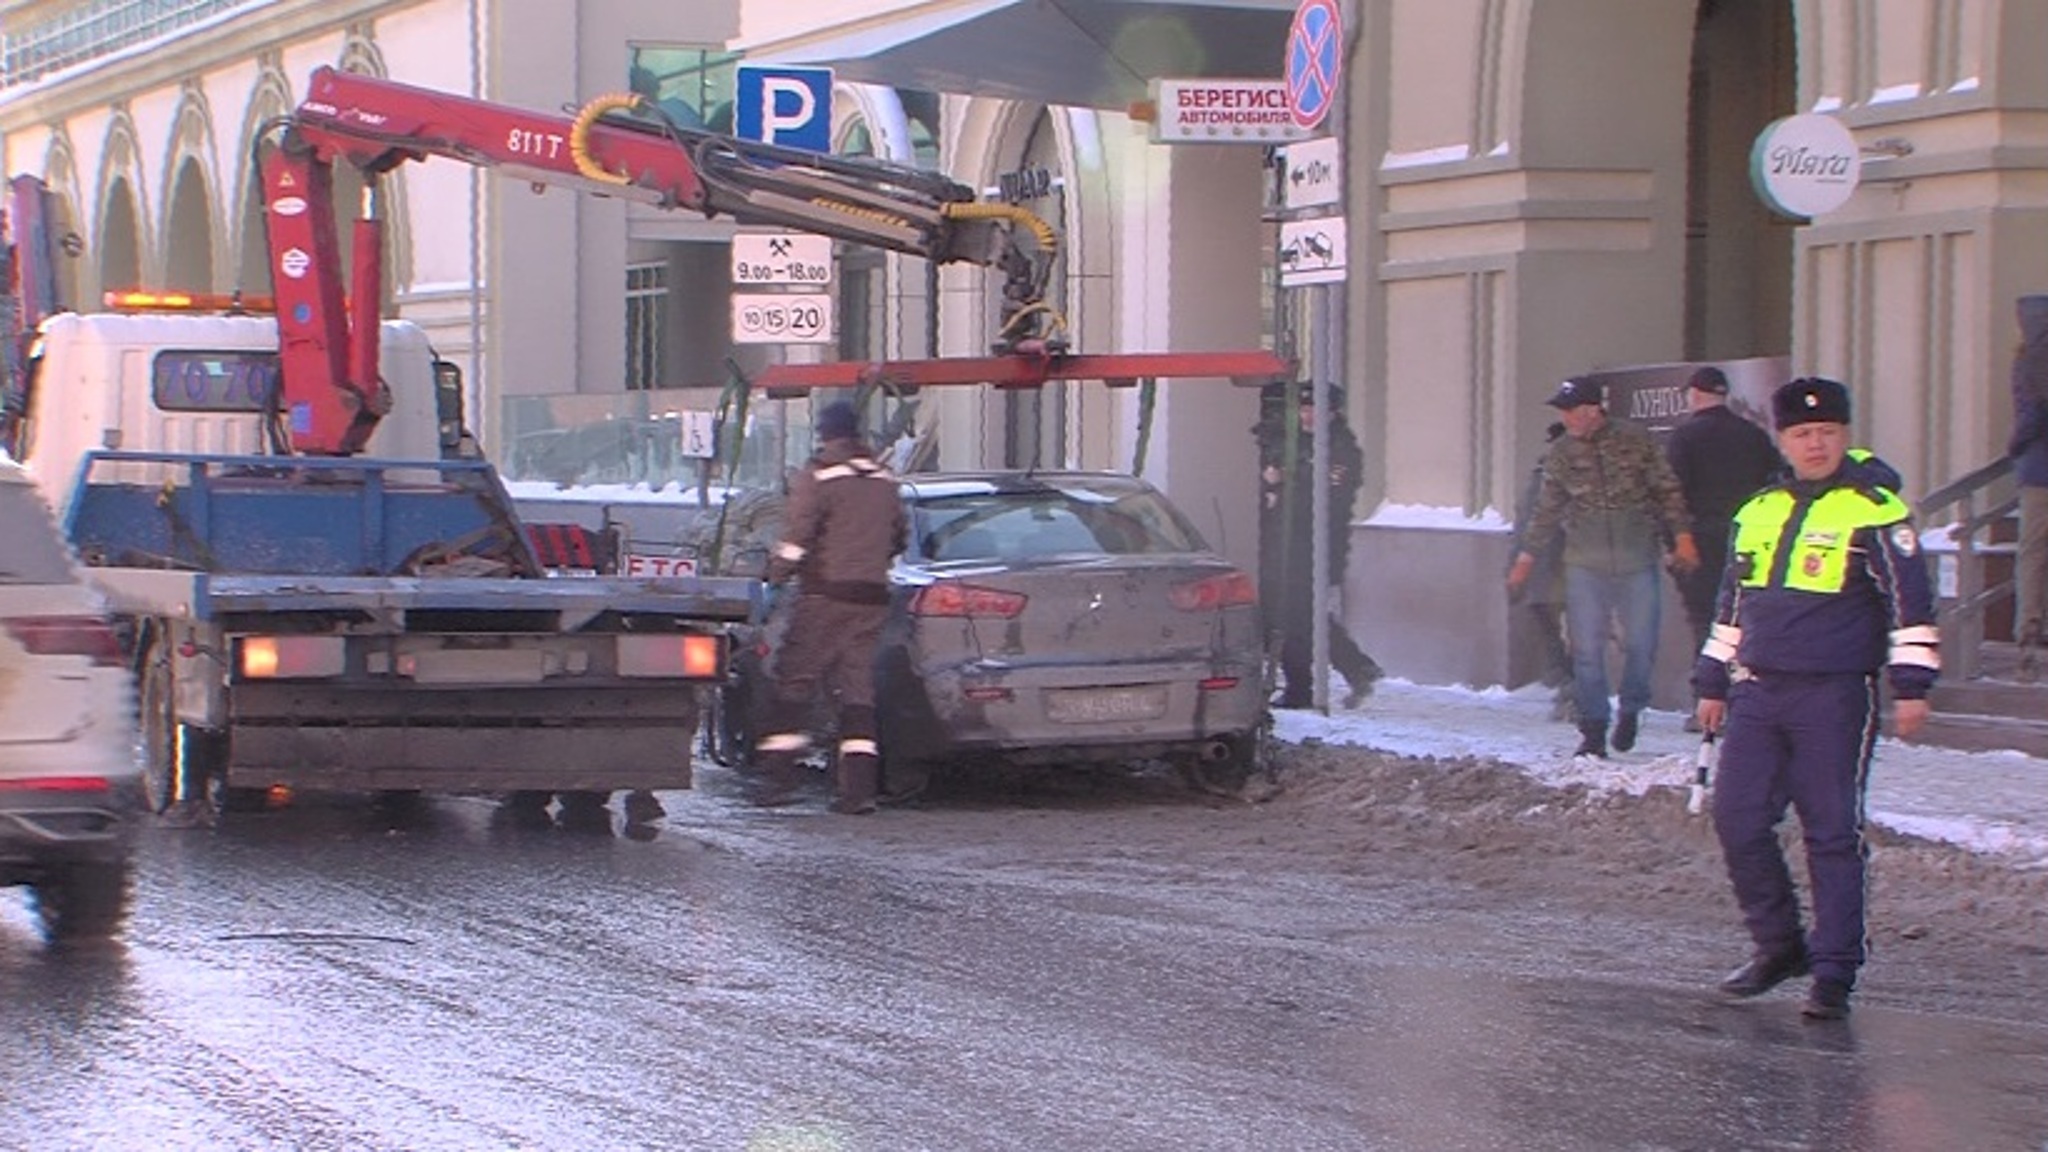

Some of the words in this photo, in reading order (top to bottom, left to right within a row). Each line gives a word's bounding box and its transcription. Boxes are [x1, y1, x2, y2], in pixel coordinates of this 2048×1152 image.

[761, 76, 816, 144] P
[1177, 110, 1291, 124] АВТОМОБИЛЯ
[1771, 144, 1850, 176] Мята
[745, 312, 760, 325] 10
[766, 310, 784, 327] 15
[792, 307, 819, 328] 20
